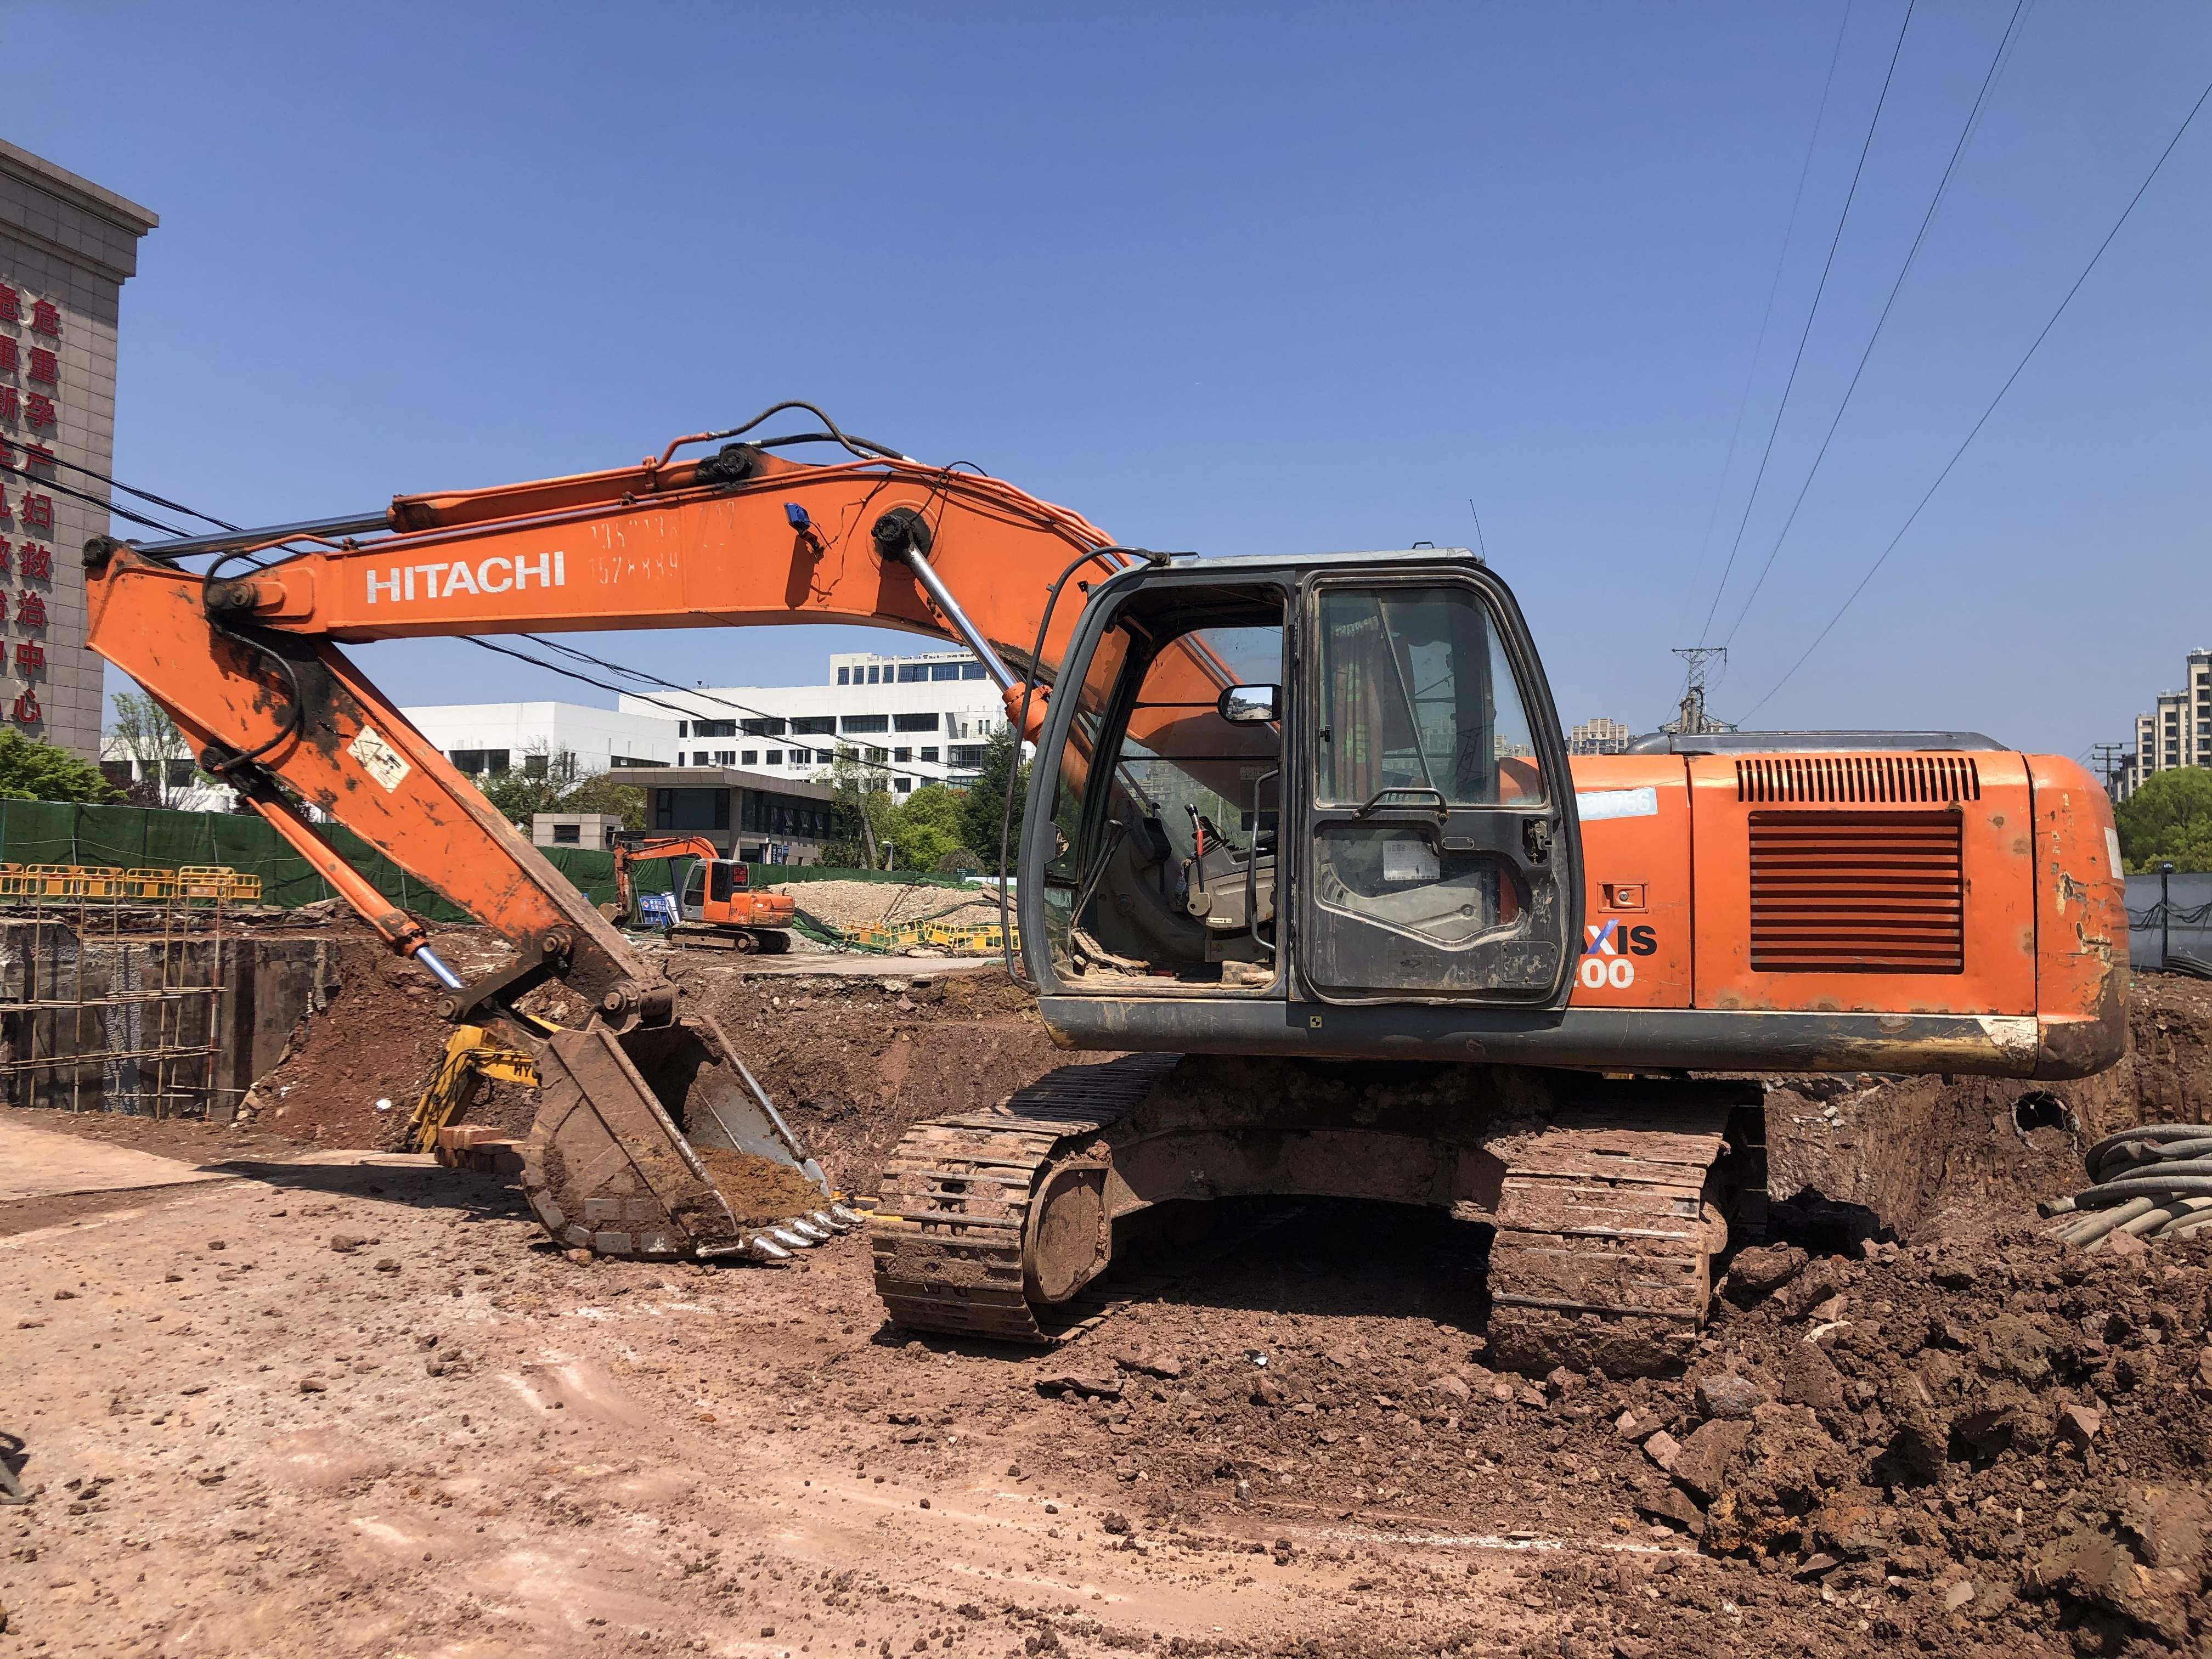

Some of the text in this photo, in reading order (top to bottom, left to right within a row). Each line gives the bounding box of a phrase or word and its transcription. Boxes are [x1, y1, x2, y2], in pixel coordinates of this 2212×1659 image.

[13, 298, 60, 723] 危重孕产妇救治中心
[366, 551, 565, 603] HITACHI
[1581, 918, 1657, 956] XIS
[1574, 958, 1635, 989] 00
